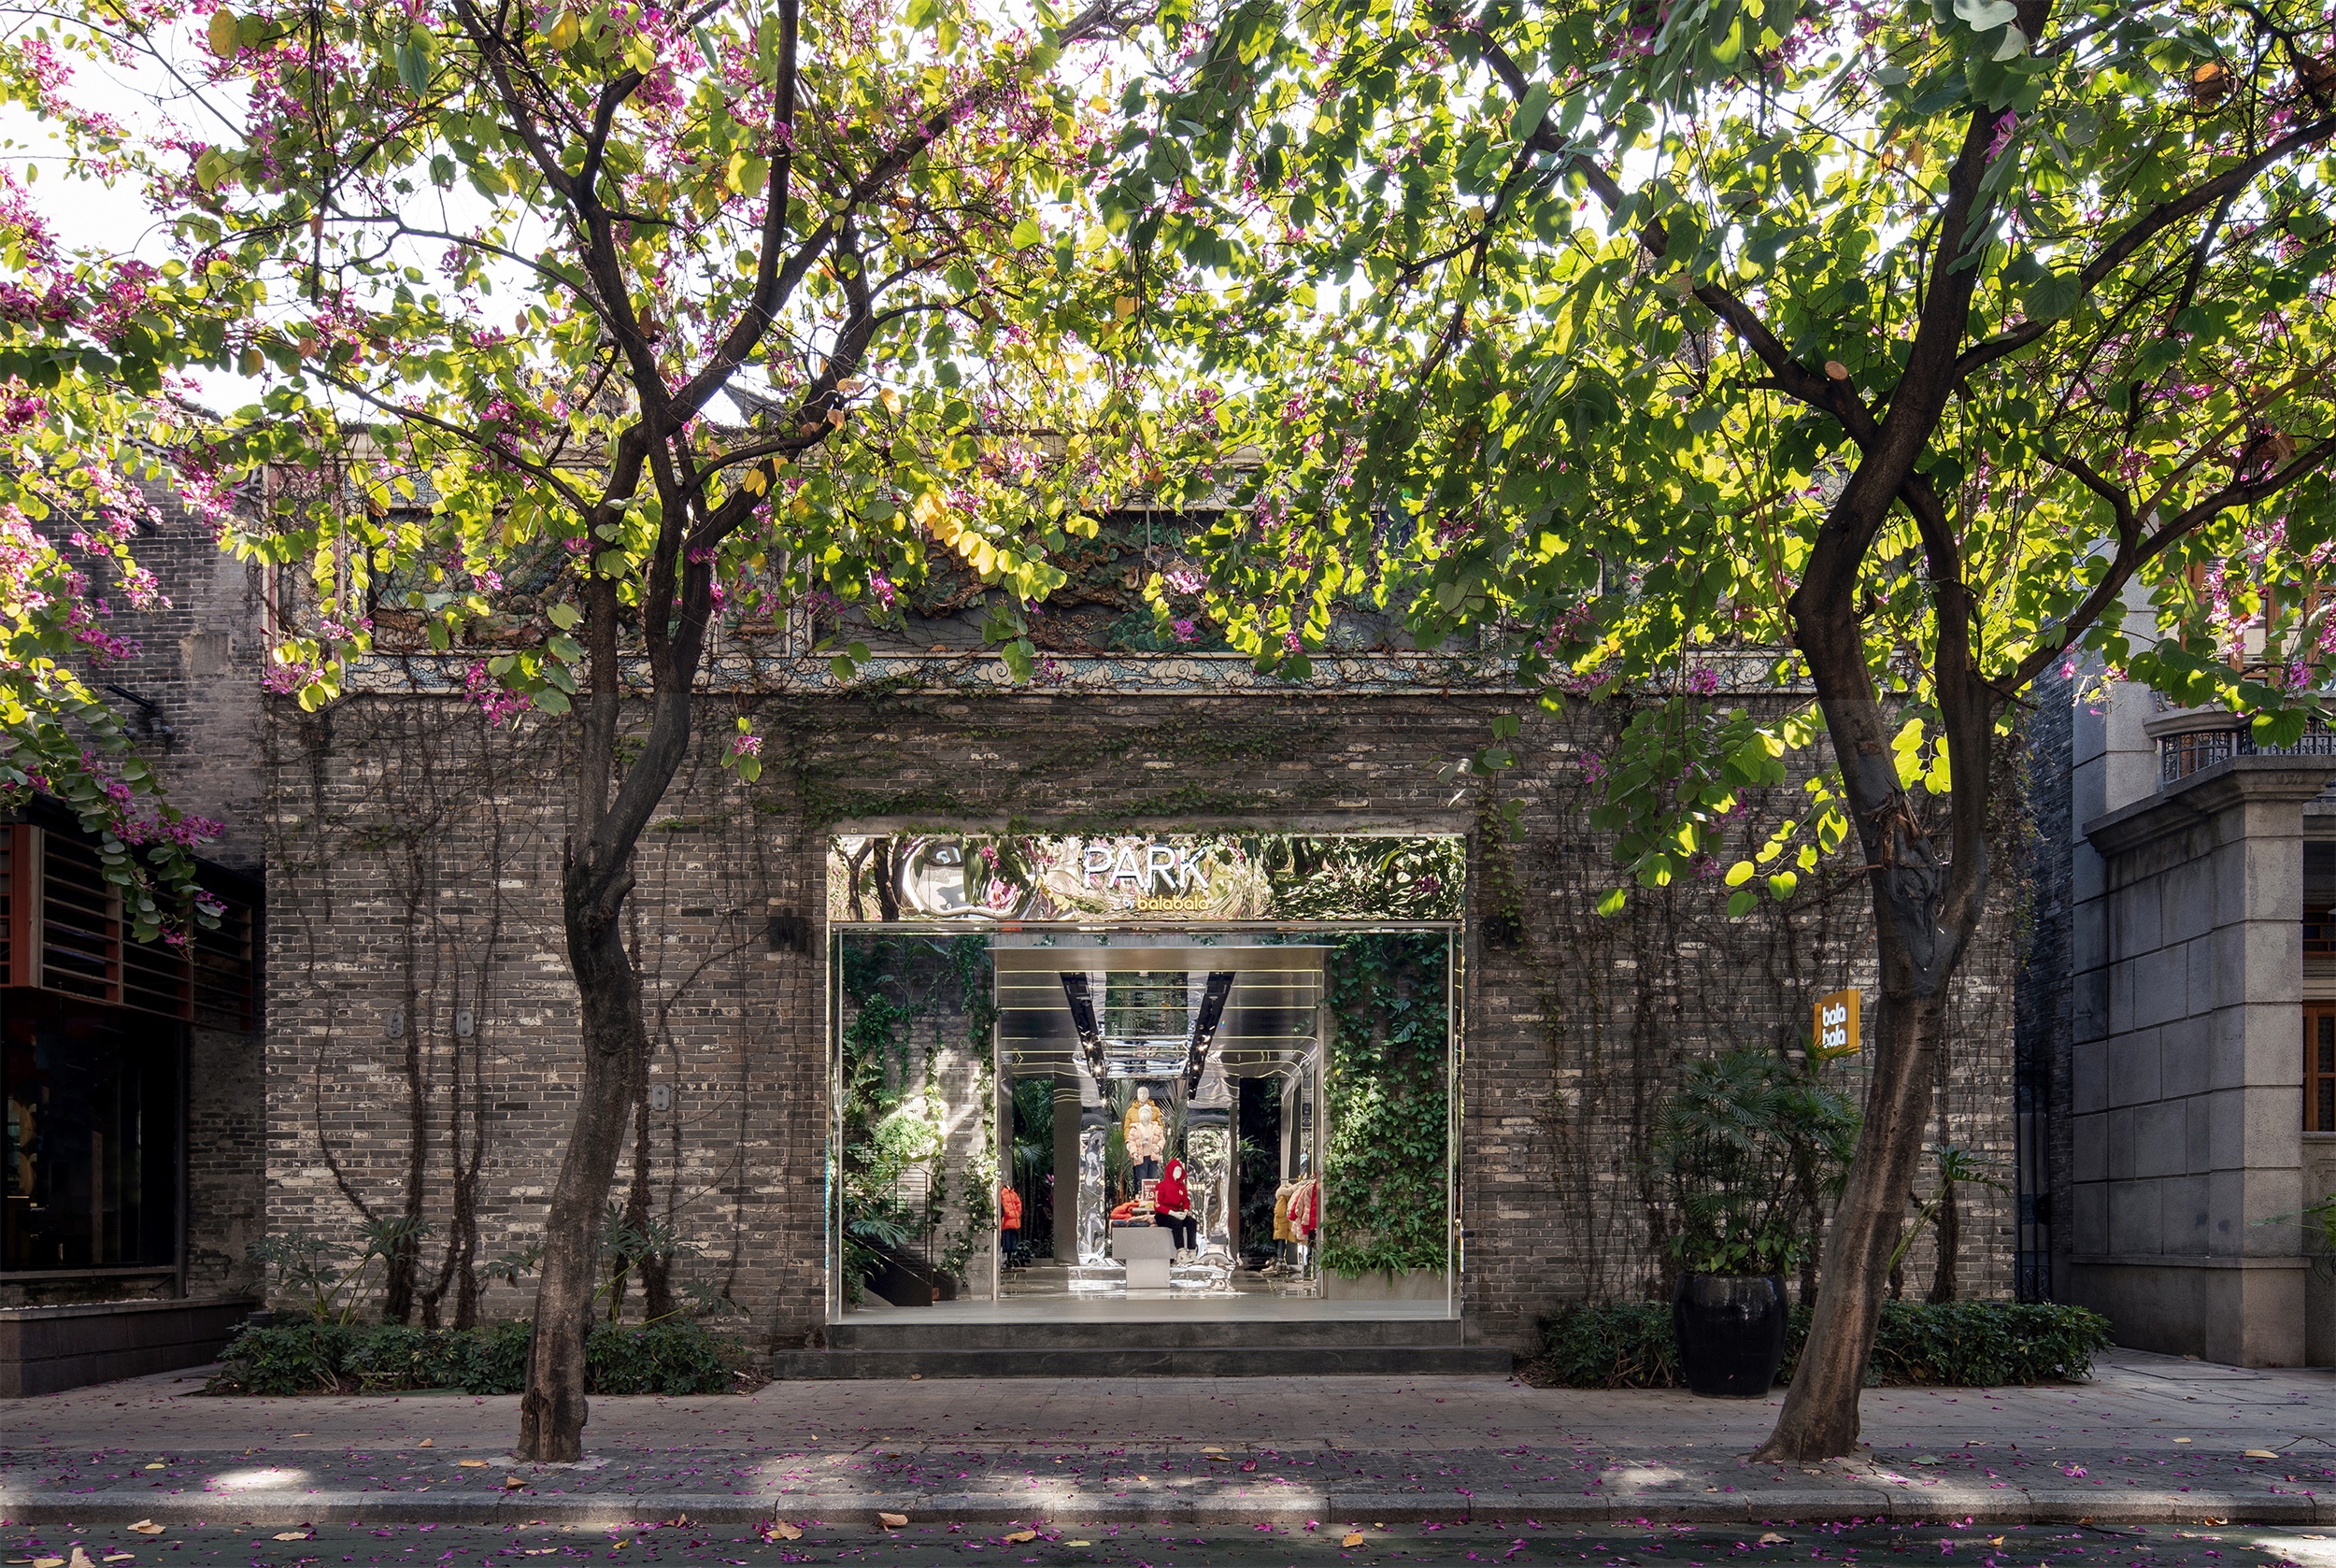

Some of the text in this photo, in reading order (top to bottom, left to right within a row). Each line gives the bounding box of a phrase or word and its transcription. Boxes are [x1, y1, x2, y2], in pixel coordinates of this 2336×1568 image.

[1084, 845, 1210, 889] PARK
[1122, 893, 1209, 911] by balabala
[1822, 1002, 1846, 1027] bala
[1822, 1024, 1846, 1048] bala
